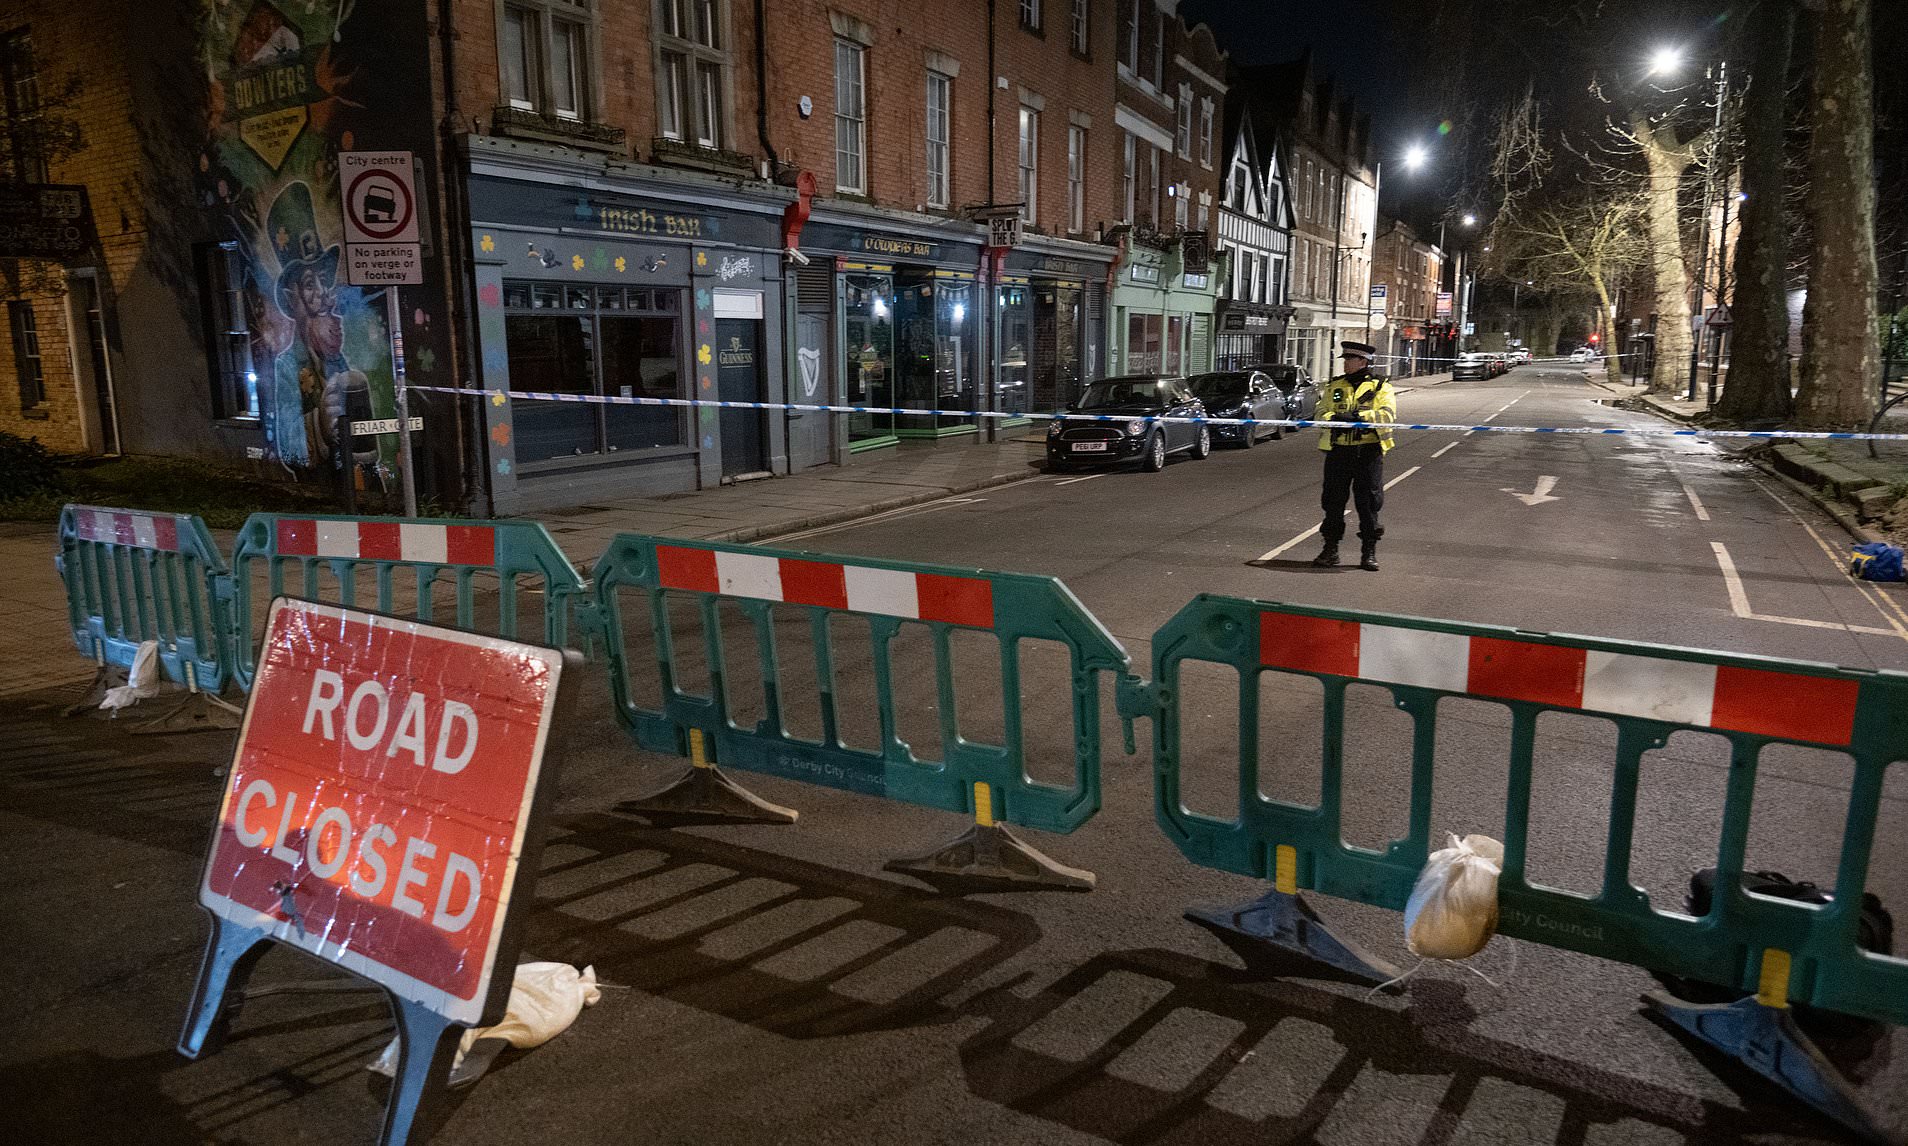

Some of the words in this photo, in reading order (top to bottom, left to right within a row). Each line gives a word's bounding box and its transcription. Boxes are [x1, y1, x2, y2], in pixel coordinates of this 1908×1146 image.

[346, 156, 368, 166] City
[371, 156, 406, 165] centre
[992, 232, 1007, 247] THE
[354, 248, 370, 257] No
[373, 248, 413, 258] parking
[355, 261, 368, 269] on
[371, 261, 401, 270] verge
[404, 260, 415, 268] or
[365, 271, 407, 281] footway
[719, 351, 753, 365] GUINNESS
[352, 421, 388, 434] FRIAR
[394, 418, 421, 431] GTE
[302, 668, 479, 775] ROAD
[791, 757, 822, 774] Derby
[824, 763, 845, 779] City
[235, 779, 481, 933] CLOSED
[1536, 913, 1604, 941] Council
